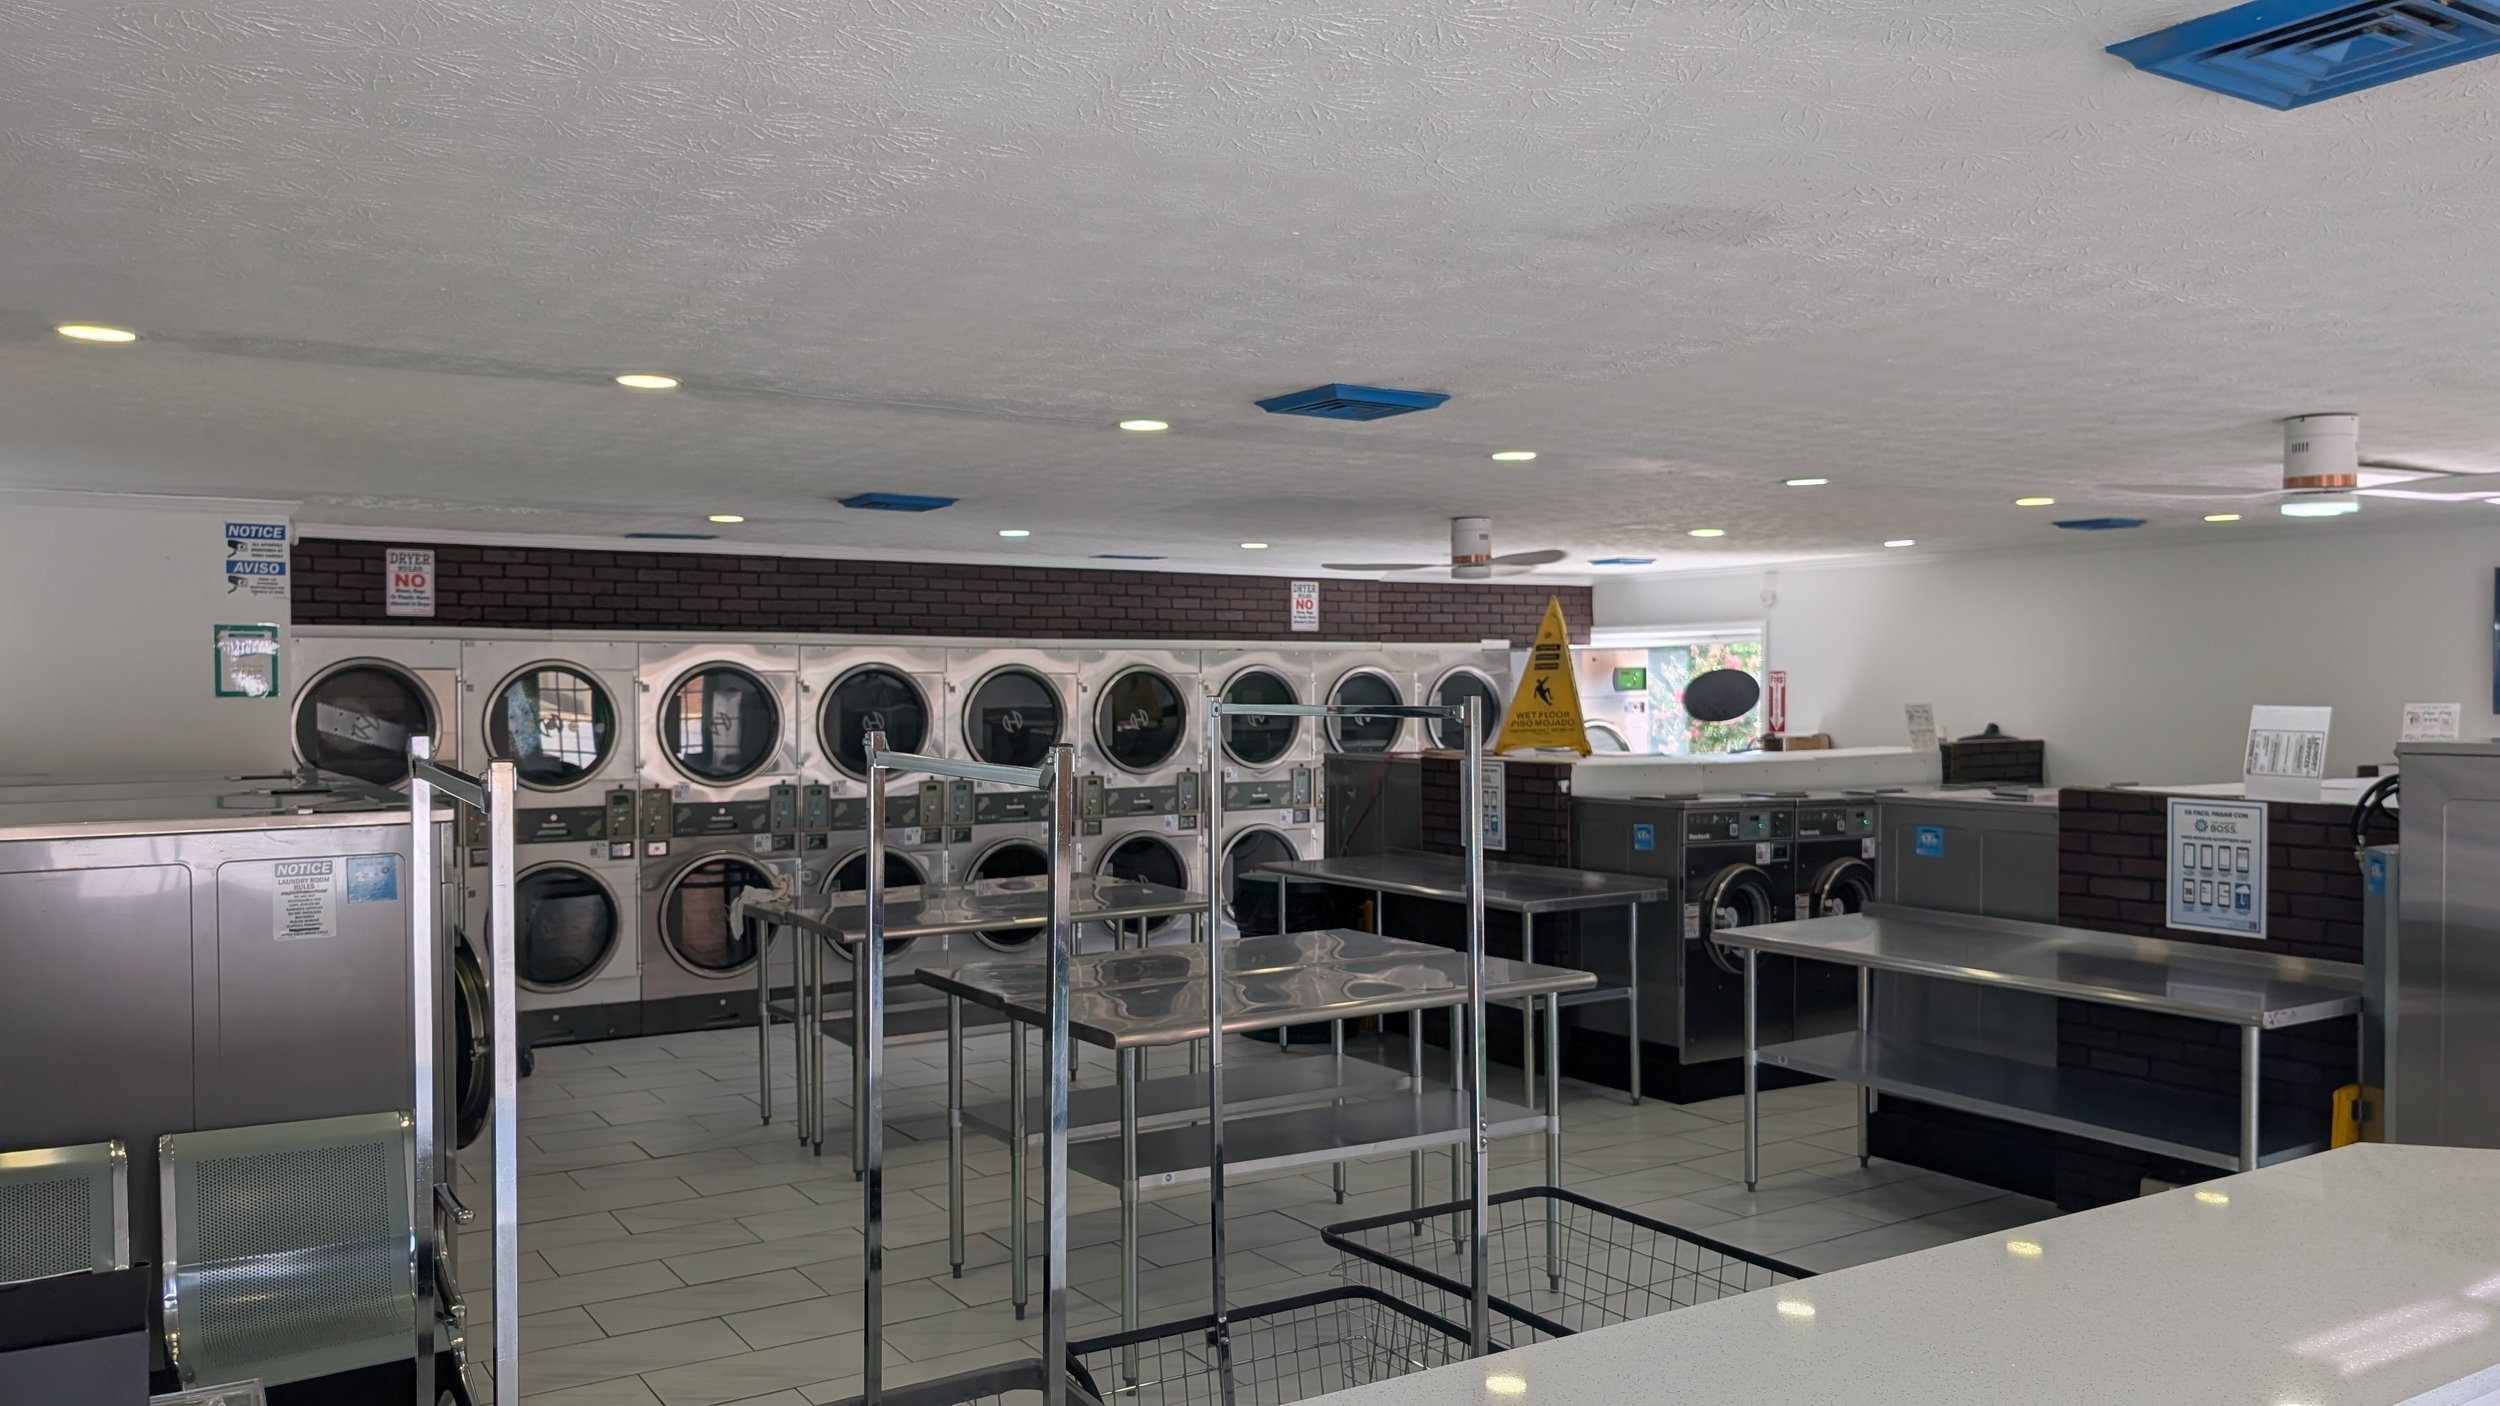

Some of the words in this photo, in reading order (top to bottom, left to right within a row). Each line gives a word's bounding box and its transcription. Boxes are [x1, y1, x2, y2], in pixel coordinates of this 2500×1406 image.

[228, 525, 283, 539] NOTICE
[390, 552, 431, 566] DRYER
[233, 561, 280, 574] AVISO
[395, 574, 426, 588] NO
[1294, 584, 1316, 593] DRYER
[1296, 599, 1314, 610] NO
[1516, 711, 1537, 719] WET
[1538, 711, 1569, 719] FLOOR
[1510, 720, 1533, 728] PISO
[1534, 719, 1575, 727] MOJADO
[277, 862, 331, 876] NOTICE
[278, 878, 308, 886] LAUNDRY
